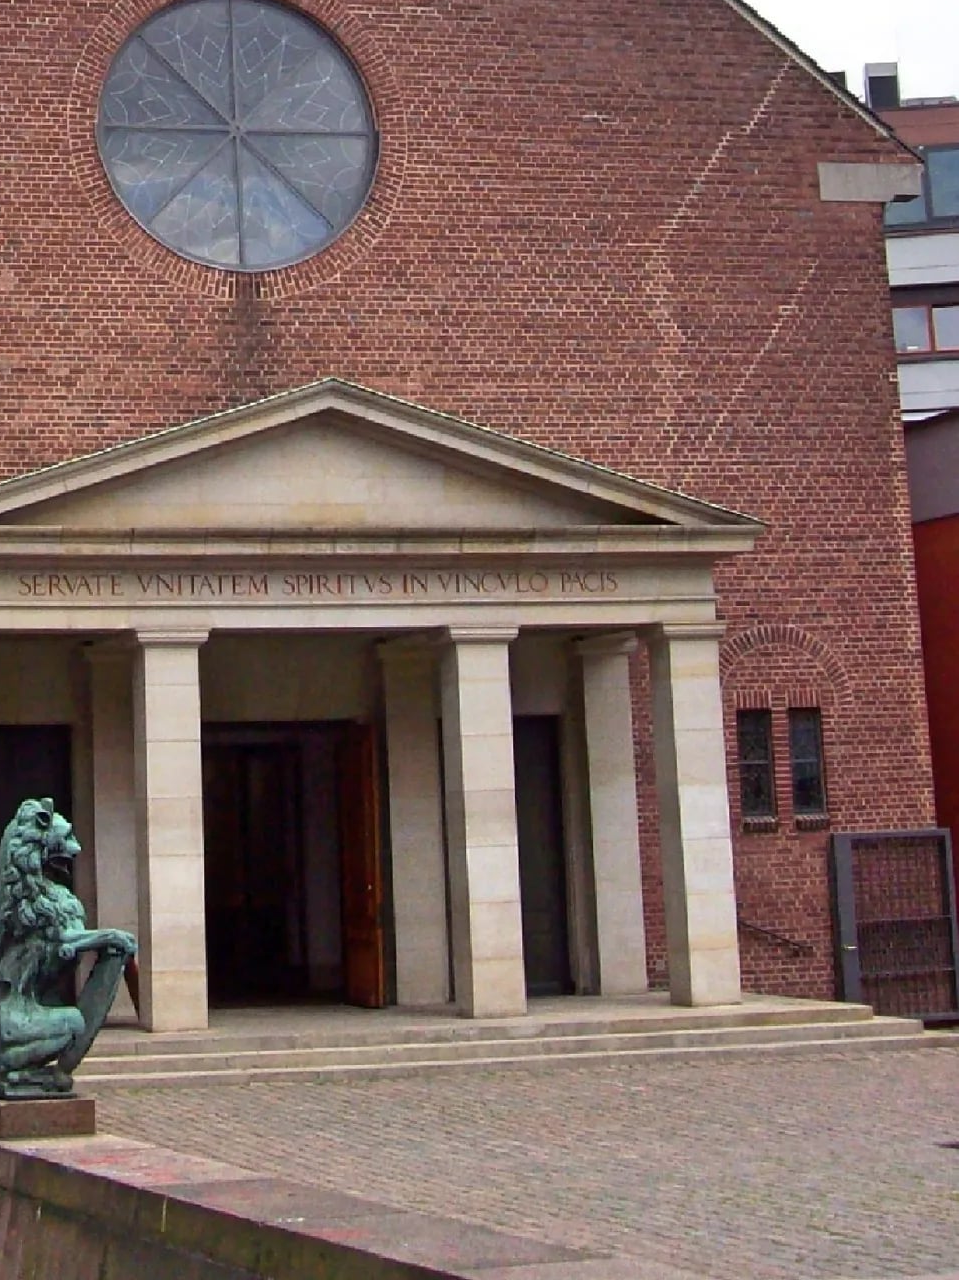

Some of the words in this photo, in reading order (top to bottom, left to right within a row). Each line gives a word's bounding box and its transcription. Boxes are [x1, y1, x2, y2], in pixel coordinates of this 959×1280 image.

[17, 574, 125, 596] SERVATE
[137, 573, 269, 596] VNITATEM
[282, 573, 393, 595] SPIRITVS
[402, 573, 429, 594] IN
[437, 572, 550, 594] VINCVLO
[560, 570, 619, 593] PACIS
